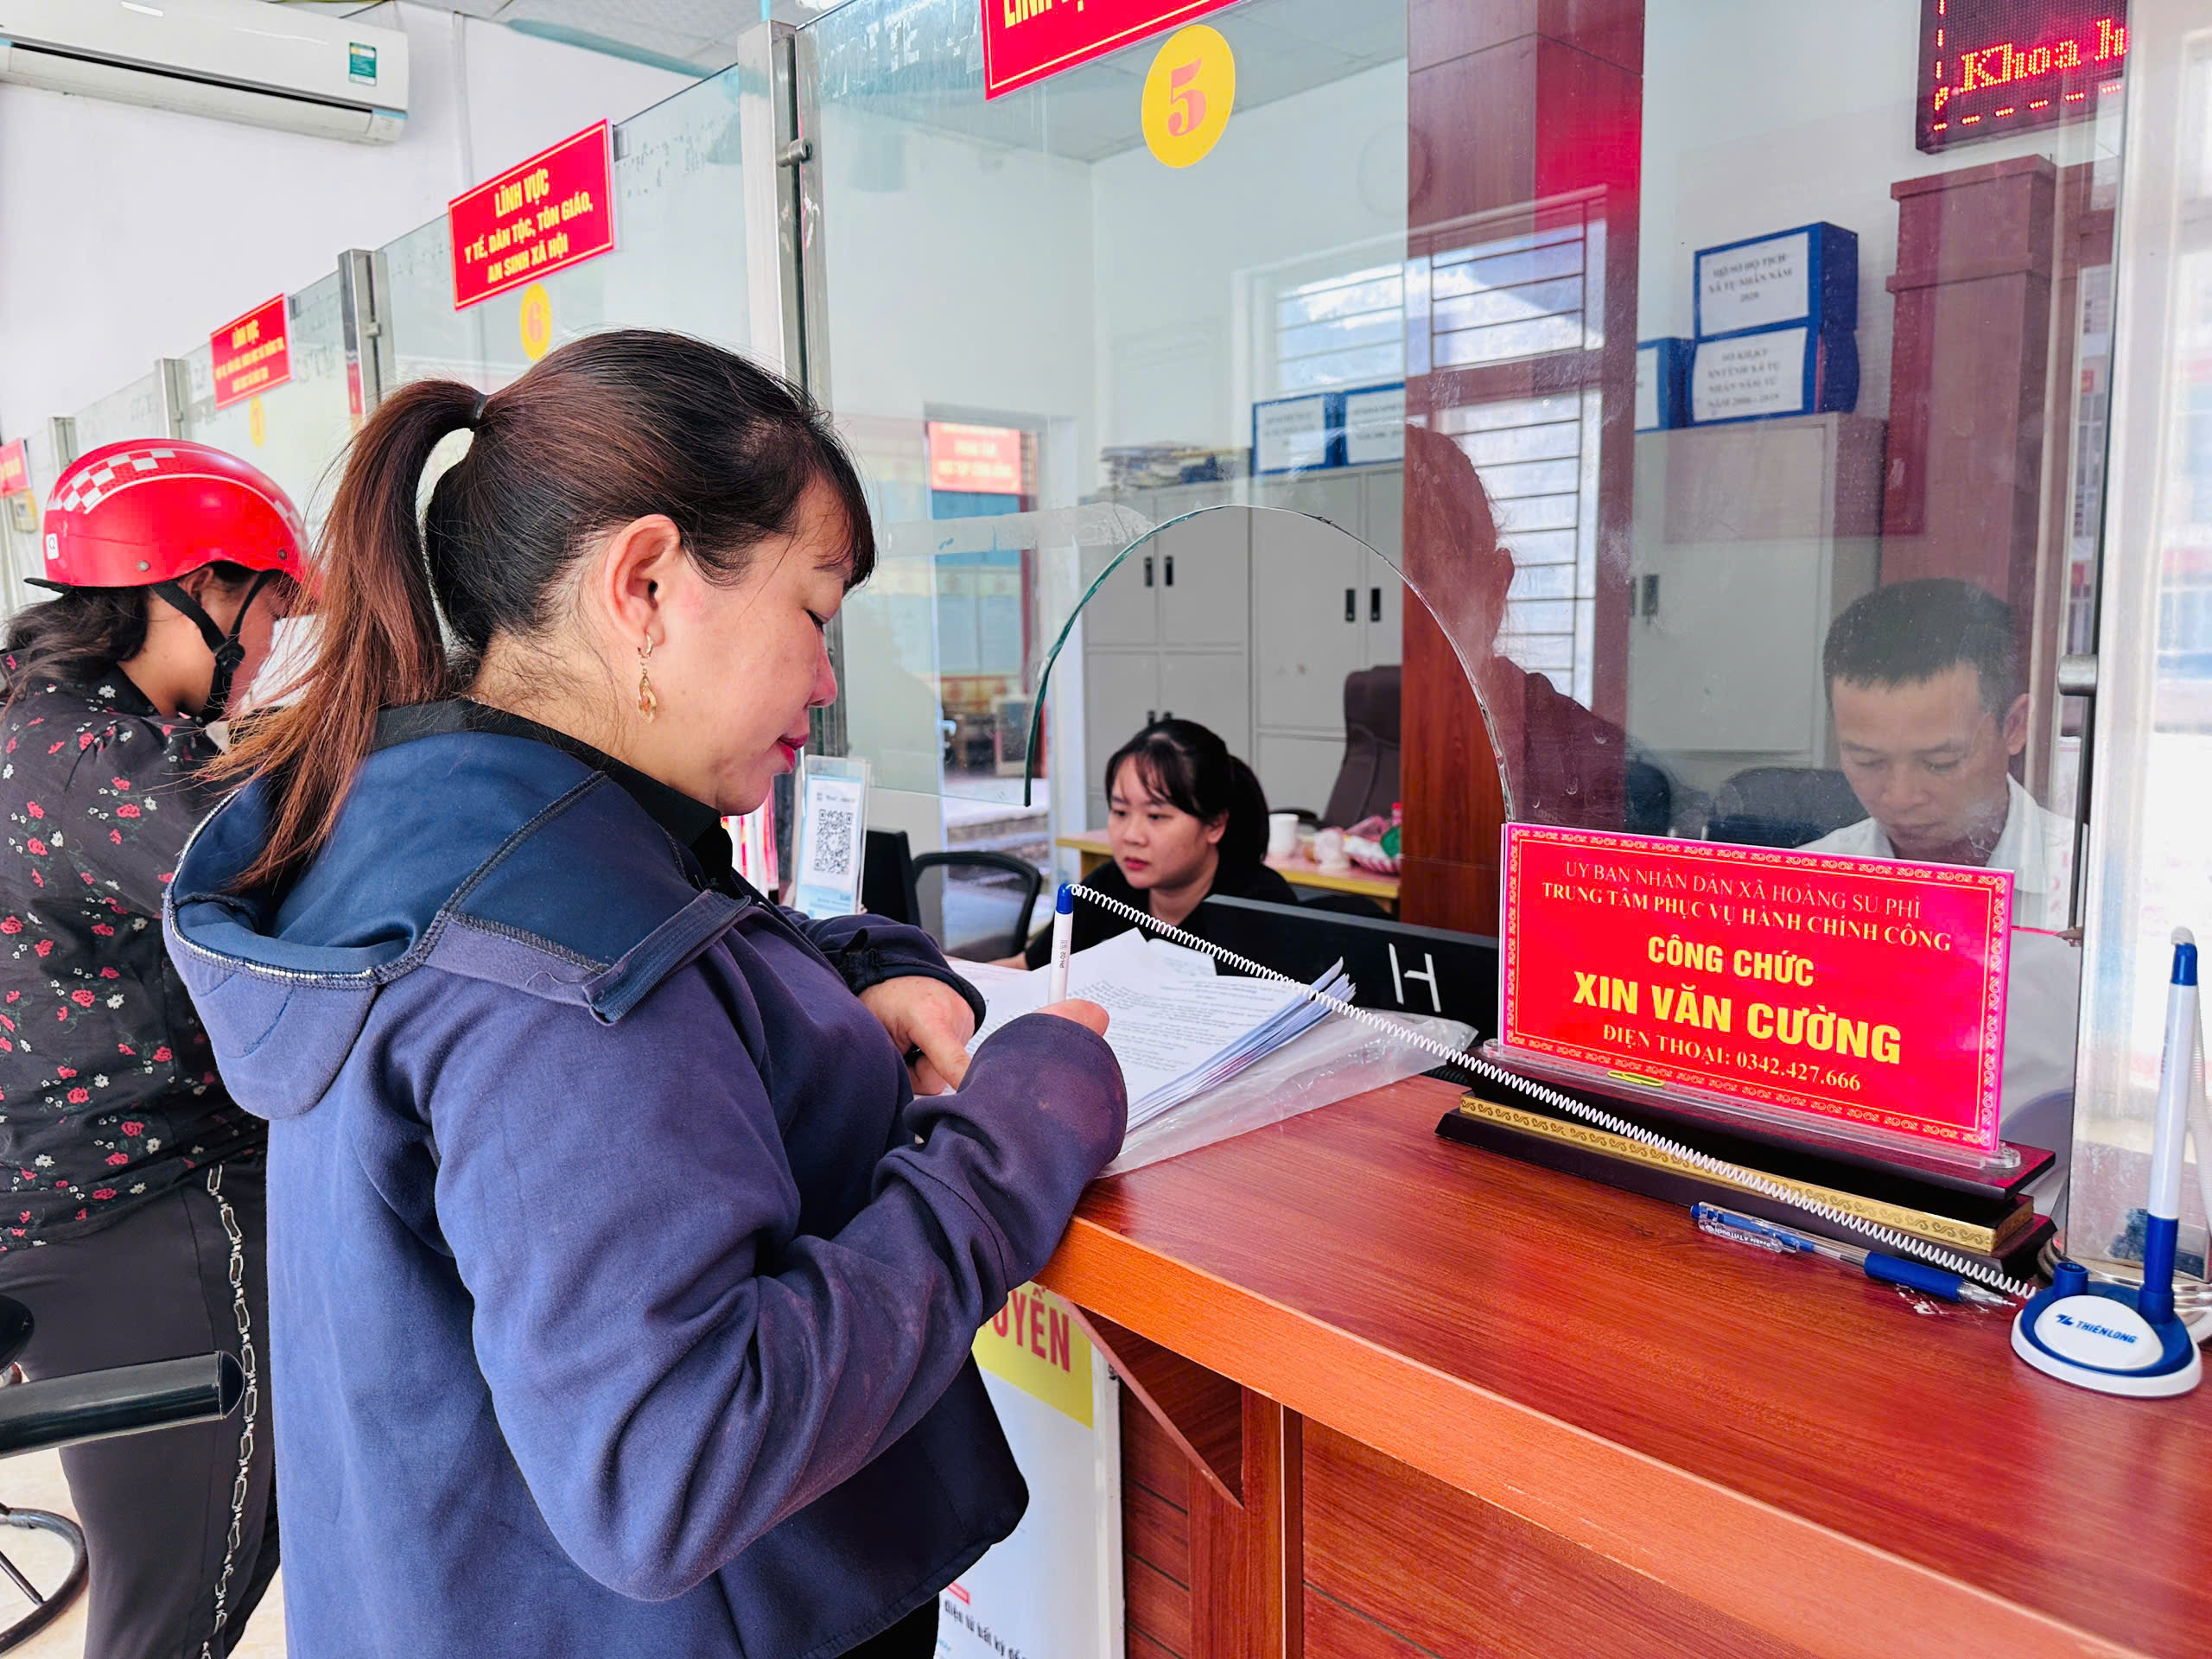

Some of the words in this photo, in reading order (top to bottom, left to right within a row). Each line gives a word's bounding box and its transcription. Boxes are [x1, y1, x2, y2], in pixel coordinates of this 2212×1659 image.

[1960, 41, 2082, 93] Khoa
[1167, 56, 1207, 137] 5
[494, 182, 523, 218] LĨNH
[523, 168, 550, 206] VỰC
[464, 246, 474, 264] Y
[536, 205, 561, 232] TÔN
[486, 262, 504, 283] AN
[504, 250, 531, 276] SINH
[1541, 881, 1603, 904] TRUNG
[1610, 887, 1648, 910] TÂM
[1654, 895, 1704, 919] PHỤC
[1709, 903, 1736, 926] VỤ
[1742, 905, 1802, 931] HÀNH
[1807, 914, 1878, 941] CHÍNH
[1885, 923, 1951, 951] CÔNG
[1594, 863, 1630, 882] BAN
[1853, 893, 1878, 913] SU
[1647, 934, 1724, 974] CÔNG
[1733, 949, 1815, 988] CHỨC
[1573, 970, 1639, 1015] XIN
[1650, 982, 1732, 1033] VĂN
[1746, 1002, 1902, 1065] CƯỜNG
[1603, 1024, 1650, 1050] ĐIỆN
[1656, 1034, 1730, 1066] THOẠI:
[1736, 1050, 1861, 1092] 0342.427.666
